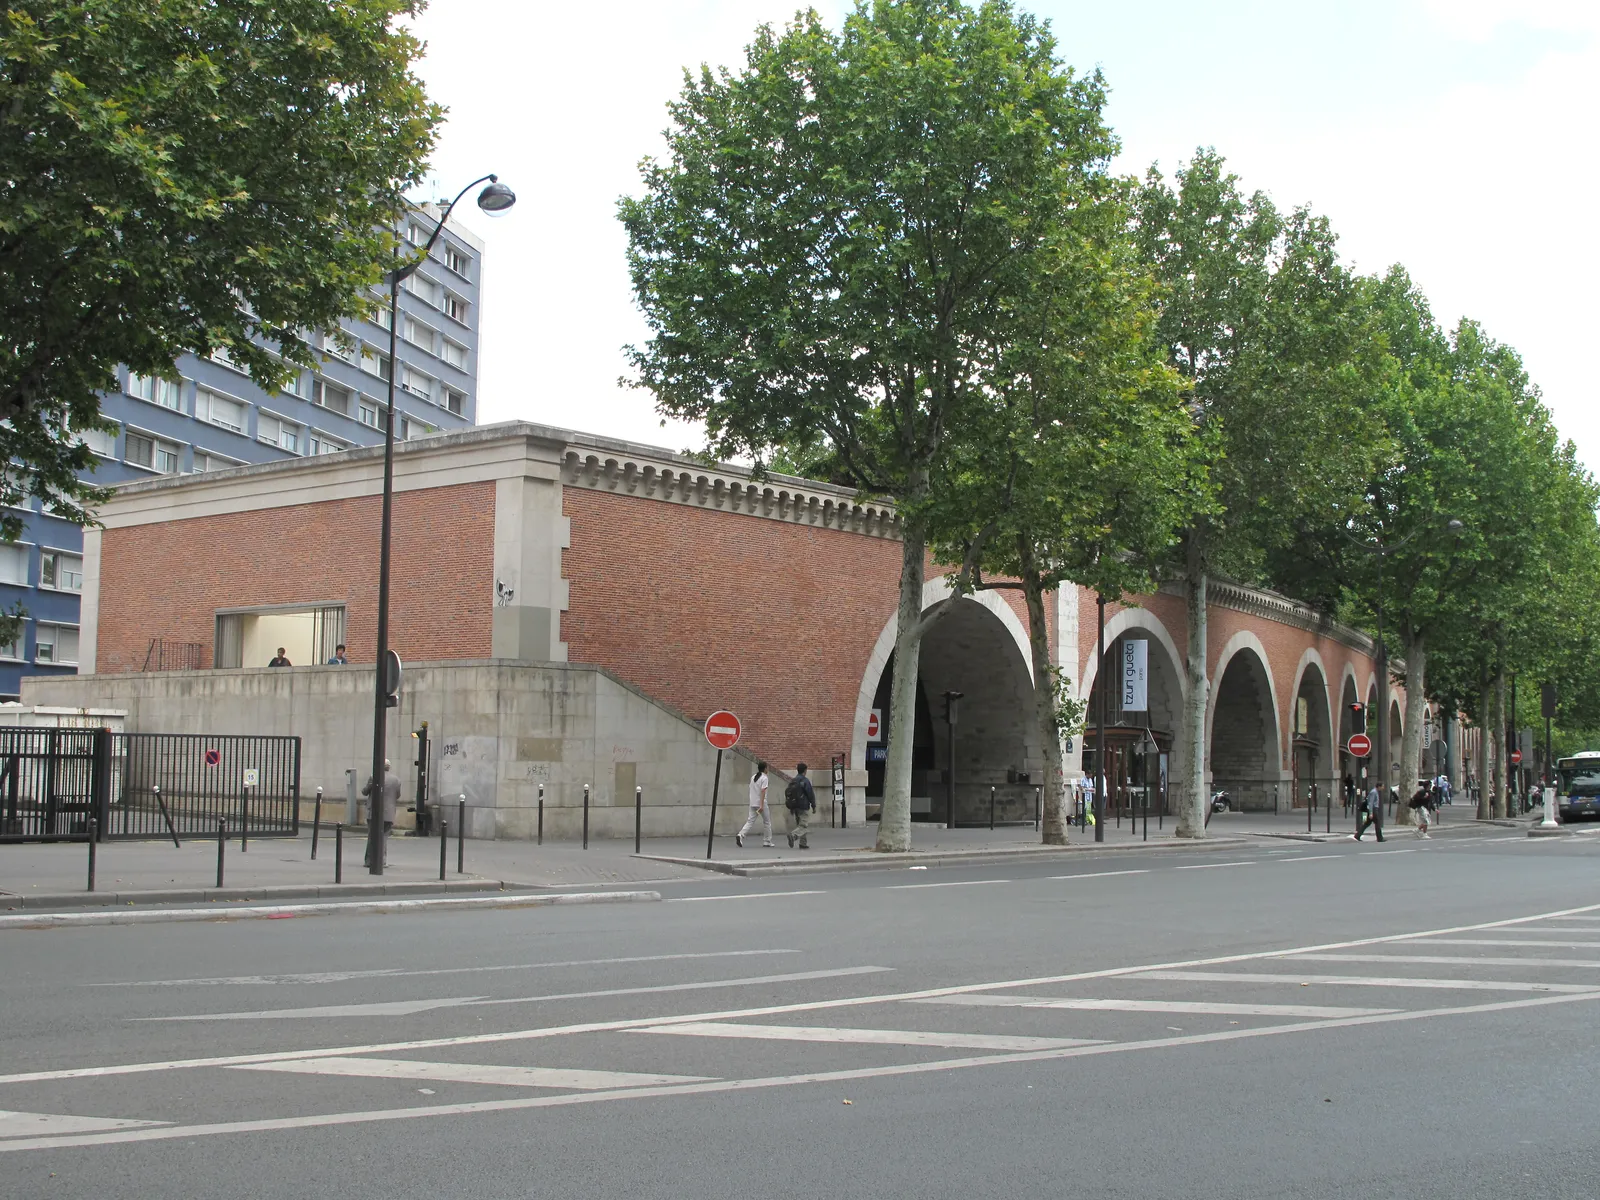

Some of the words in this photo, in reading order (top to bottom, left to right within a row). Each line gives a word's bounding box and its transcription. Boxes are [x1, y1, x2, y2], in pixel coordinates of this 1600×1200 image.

[1125, 643, 1136, 677] gueta
[1124, 679, 1134, 705] tzuri
[874, 749, 888, 759] PARK
